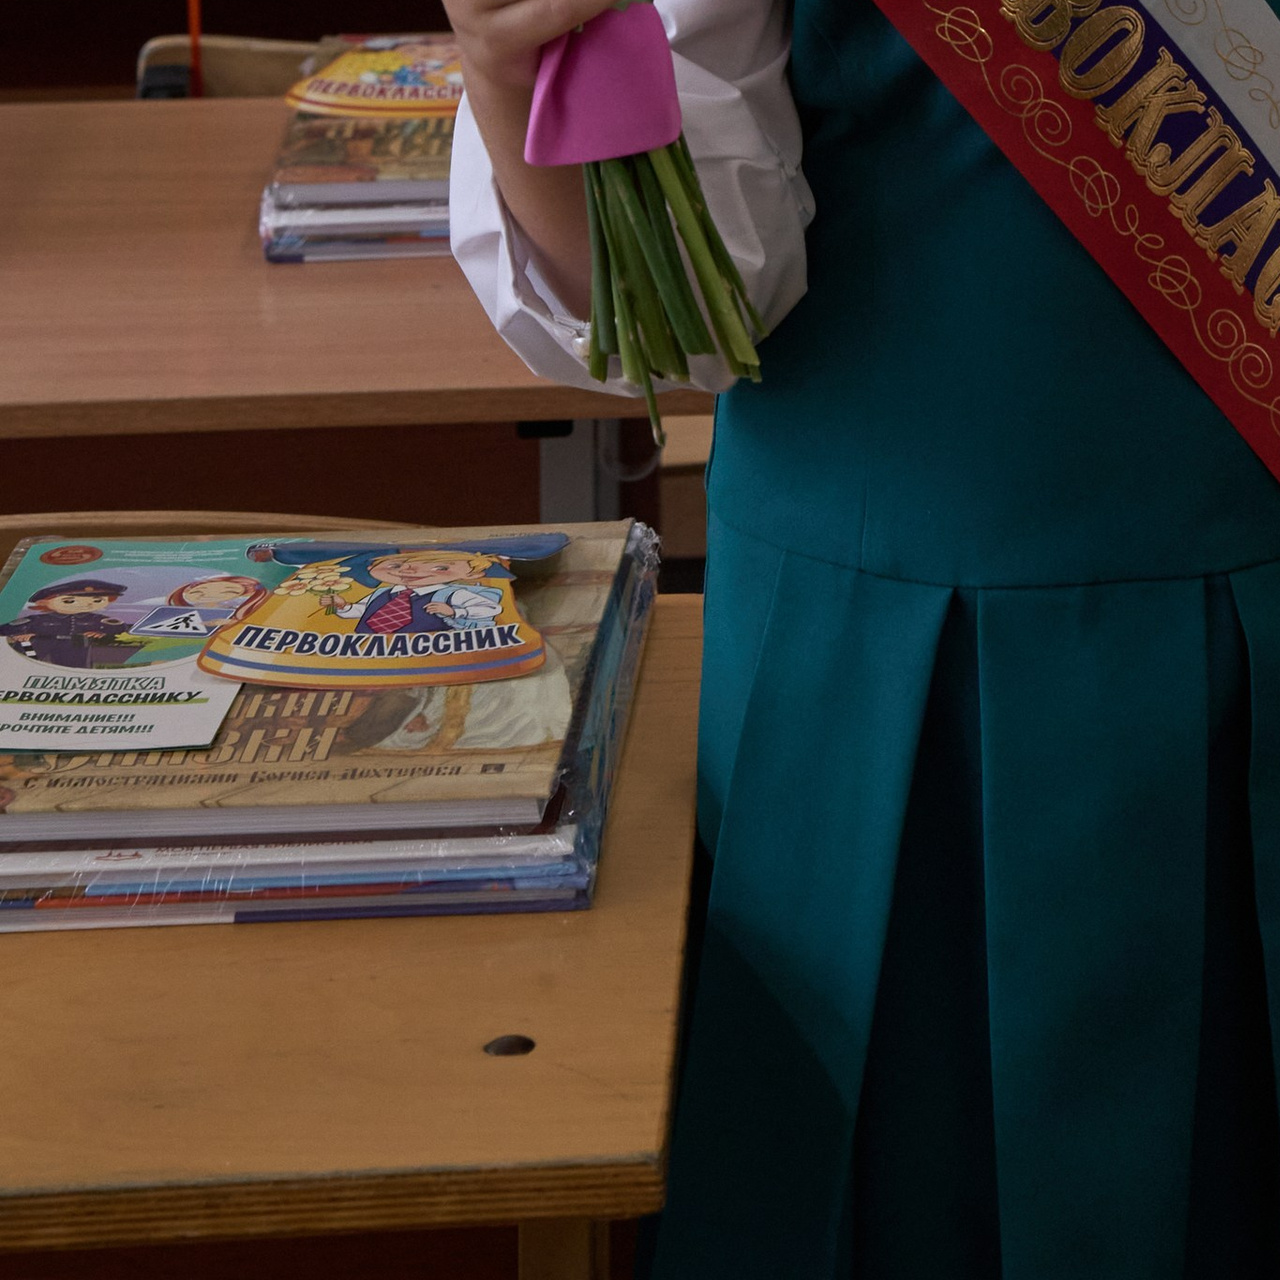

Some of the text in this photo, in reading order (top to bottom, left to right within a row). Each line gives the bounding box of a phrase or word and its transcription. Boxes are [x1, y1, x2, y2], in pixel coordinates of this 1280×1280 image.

[234, 622, 525, 658] ПЕРВОКЛАССНИК
[22, 675, 166, 690] ПАМЯТКА
[0, 690, 203, 704] РВОКЛАССНИКУ
[19, 712, 136, 723] ВНИМАНИЕ!!!
[0, 723, 155, 734] РОЧТИТЕ ДЕТЯМ!!!
